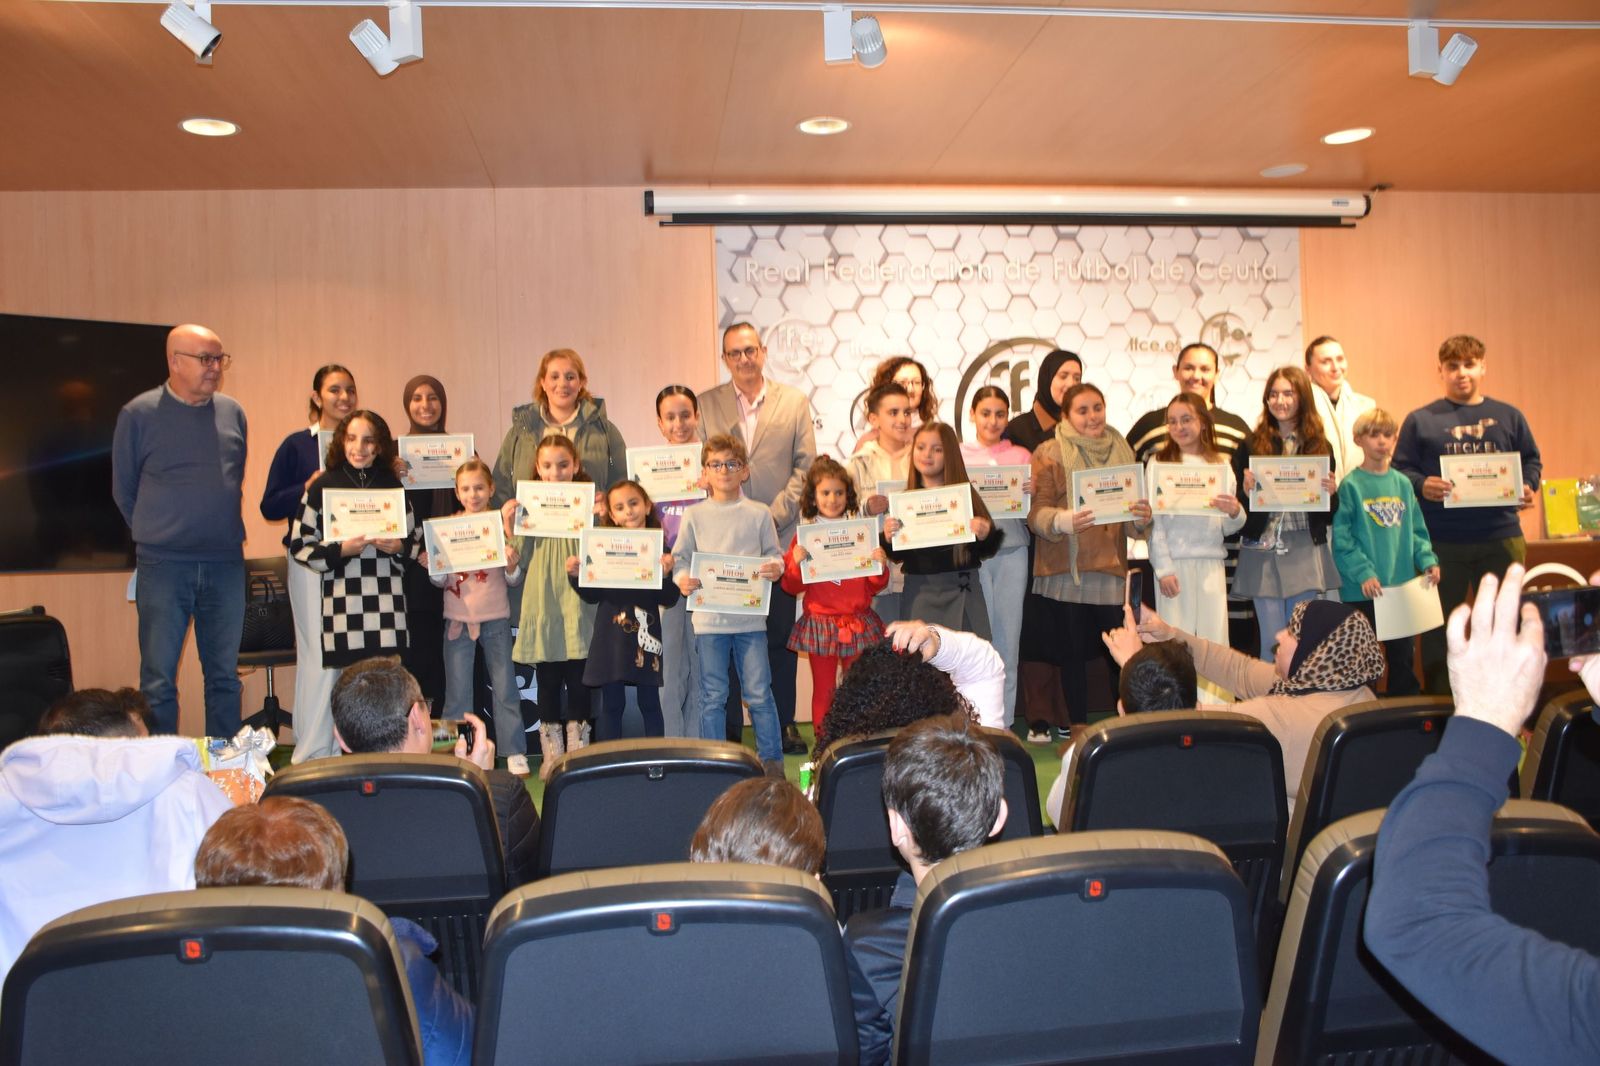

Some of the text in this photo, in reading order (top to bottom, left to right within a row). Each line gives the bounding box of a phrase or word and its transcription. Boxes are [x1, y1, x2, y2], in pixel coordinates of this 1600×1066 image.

[745, 255, 1279, 282] Real Federación de Fútbol de Ceuta
